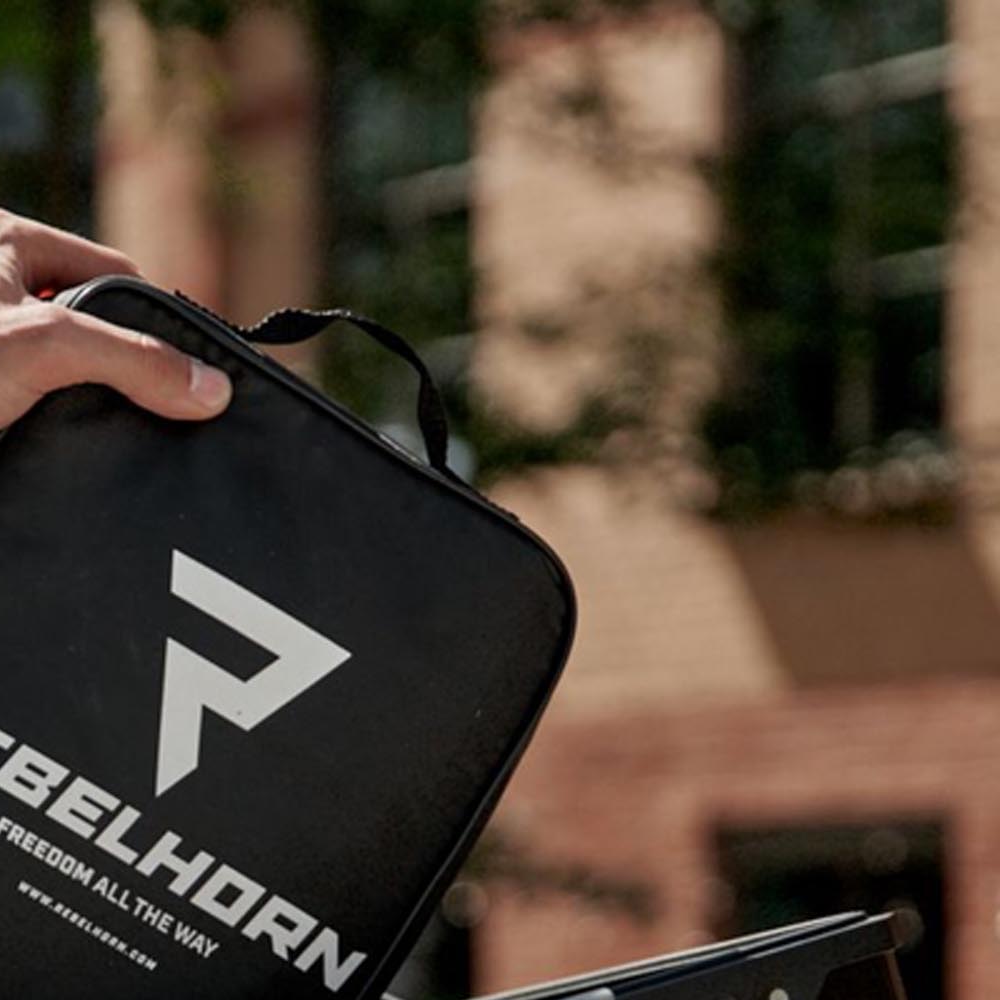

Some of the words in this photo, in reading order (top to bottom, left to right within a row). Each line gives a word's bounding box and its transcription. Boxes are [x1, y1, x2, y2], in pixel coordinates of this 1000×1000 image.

[92, 876, 130, 911] ALL
[133, 897, 175, 934] THE
[174, 922, 220, 958] WAY
